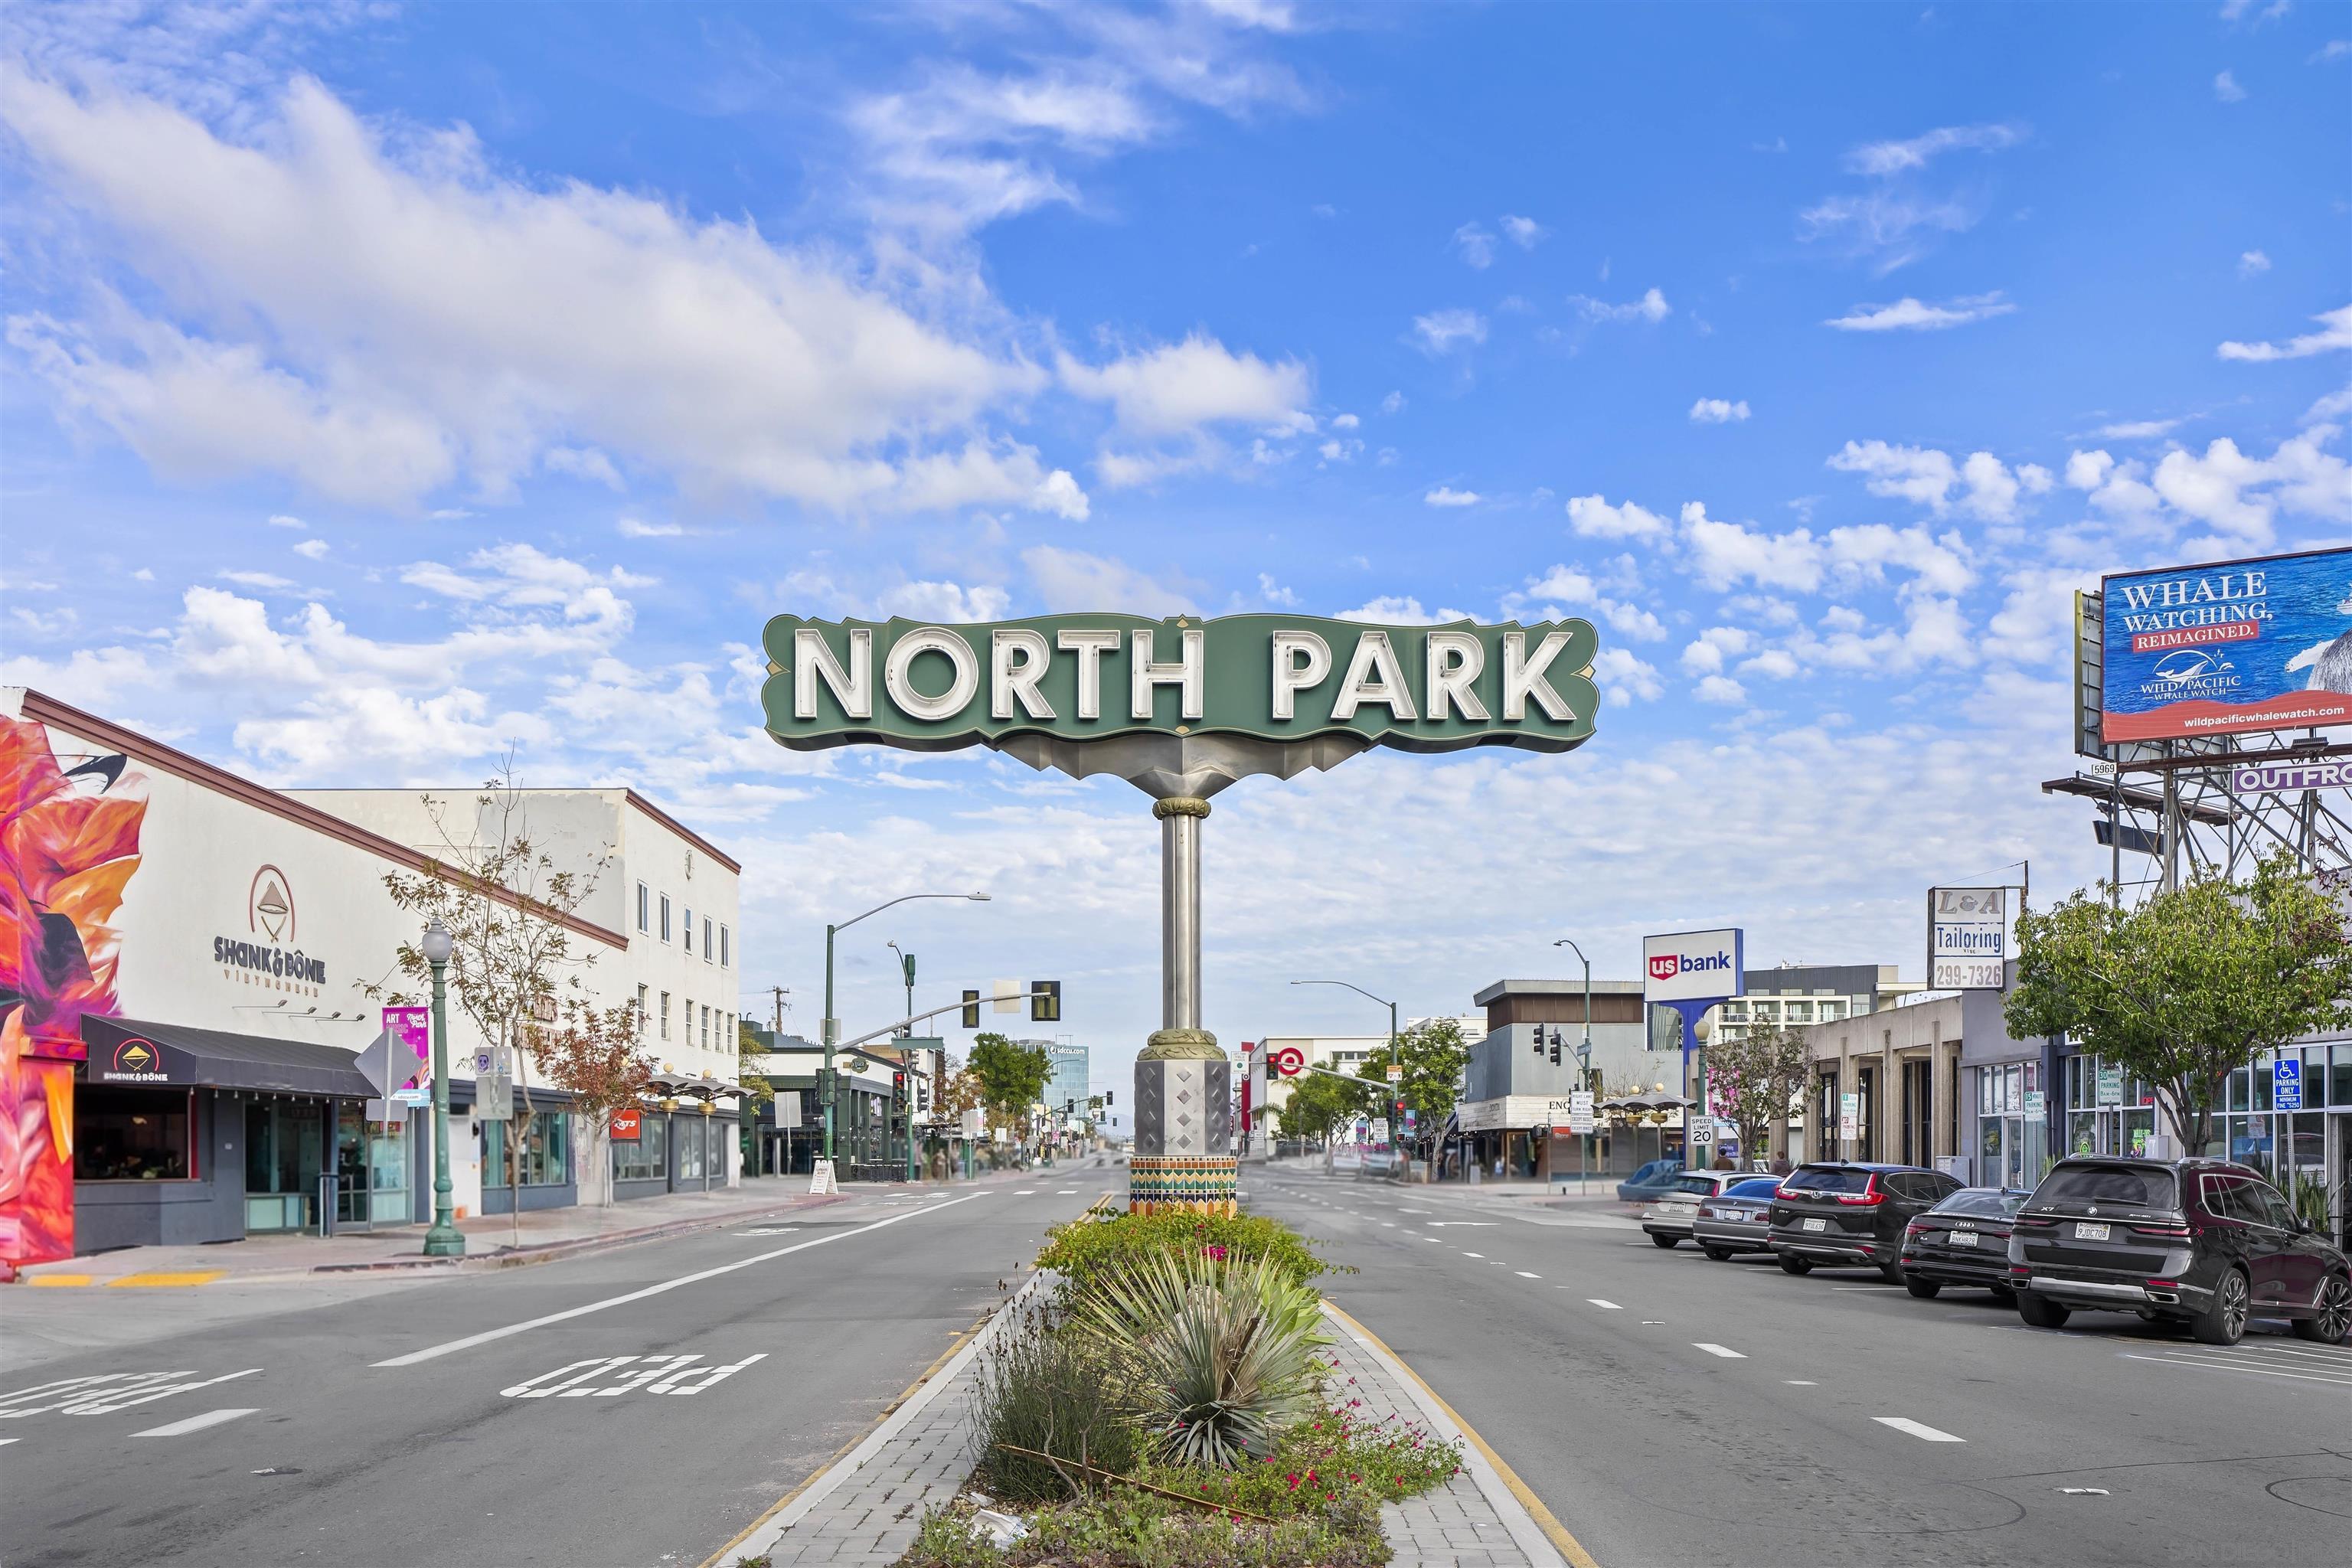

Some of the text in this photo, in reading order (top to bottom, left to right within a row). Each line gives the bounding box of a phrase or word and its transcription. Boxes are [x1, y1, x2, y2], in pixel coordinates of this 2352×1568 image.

[2121, 572, 2267, 609] WHALE
[2123, 602, 2273, 632] WATCHING,
[2137, 624, 2254, 649] REIMAGINED.
[794, 628, 1577, 722] NORTH PARK
[2141, 675, 2241, 694] WILD PACIFIC
[2154, 688, 2226, 701] WHALE WATCH
[2184, 706, 2345, 728] wildpacificwhalewatch.com
[2094, 764, 2115, 775] 5969
[1937, 927, 2001, 953] Tailoring
[1937, 965, 2001, 986] 299-7326
[386, 1013, 400, 1024] ART
[1057, 1047, 1085, 1055] sdccu.com
[2099, 1071, 2106, 1080] 30
[2276, 1078, 2299, 1086] PARKING
[1694, 1131, 1711, 1142] 20
[2077, 1228, 2107, 1238] 9JDC708
